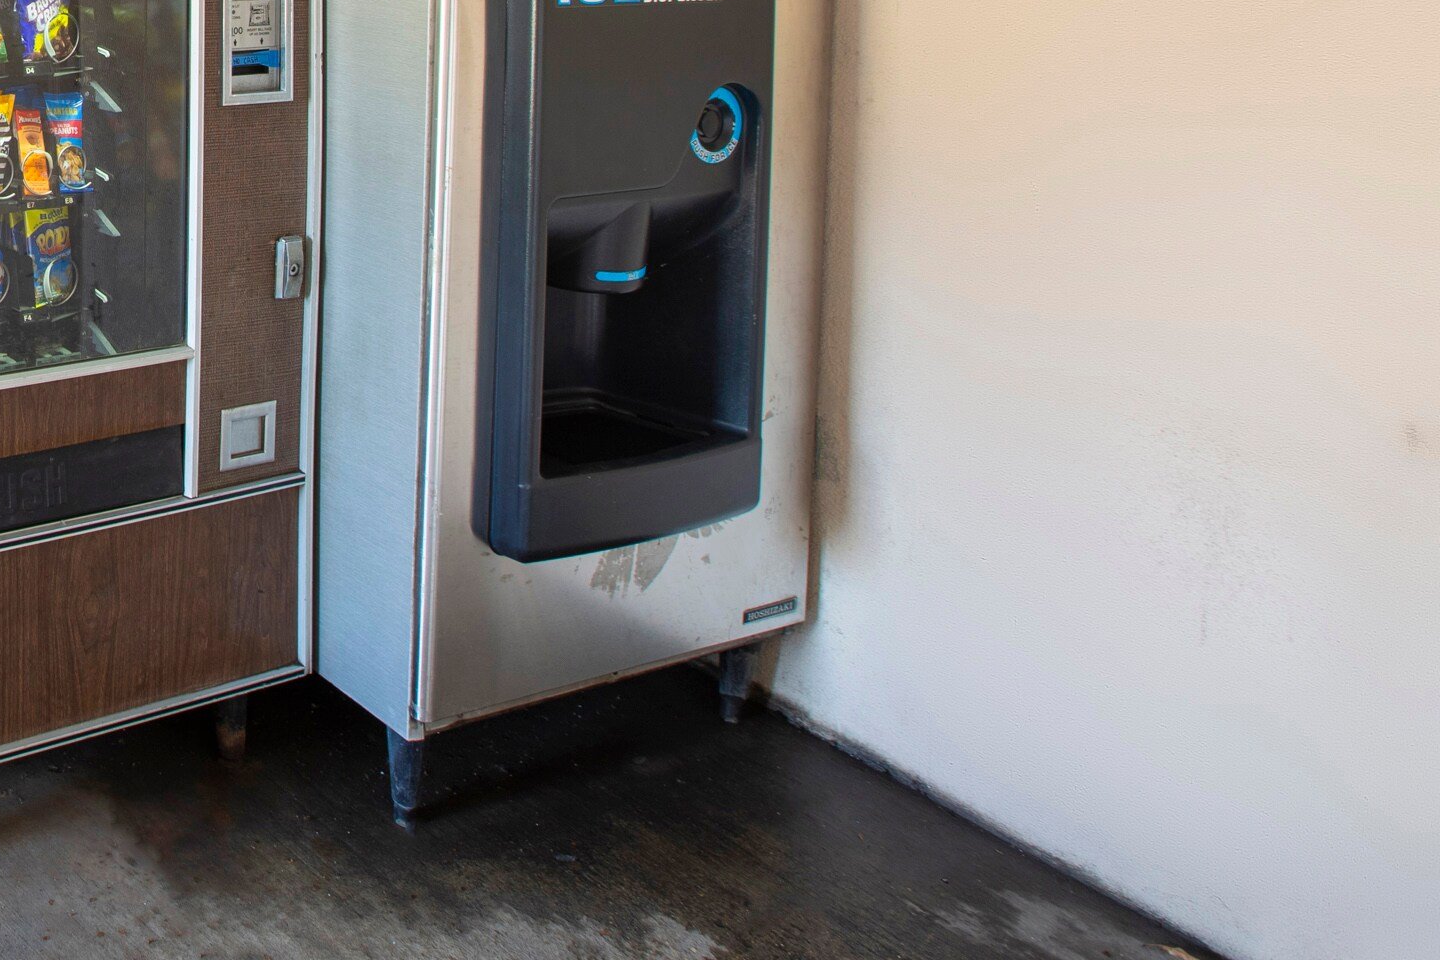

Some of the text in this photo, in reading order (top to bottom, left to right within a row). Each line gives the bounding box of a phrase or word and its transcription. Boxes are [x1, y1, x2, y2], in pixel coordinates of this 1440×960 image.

[243, 56, 259, 65] CASH
[50, 126, 79, 135] PEANUTS
[690, 139, 738, 160] PUSH FOR ICE
[26, 201, 36, 209] E7
[23, 314, 32, 322] F4
[748, 601, 793, 620] HOSHIZAKI
